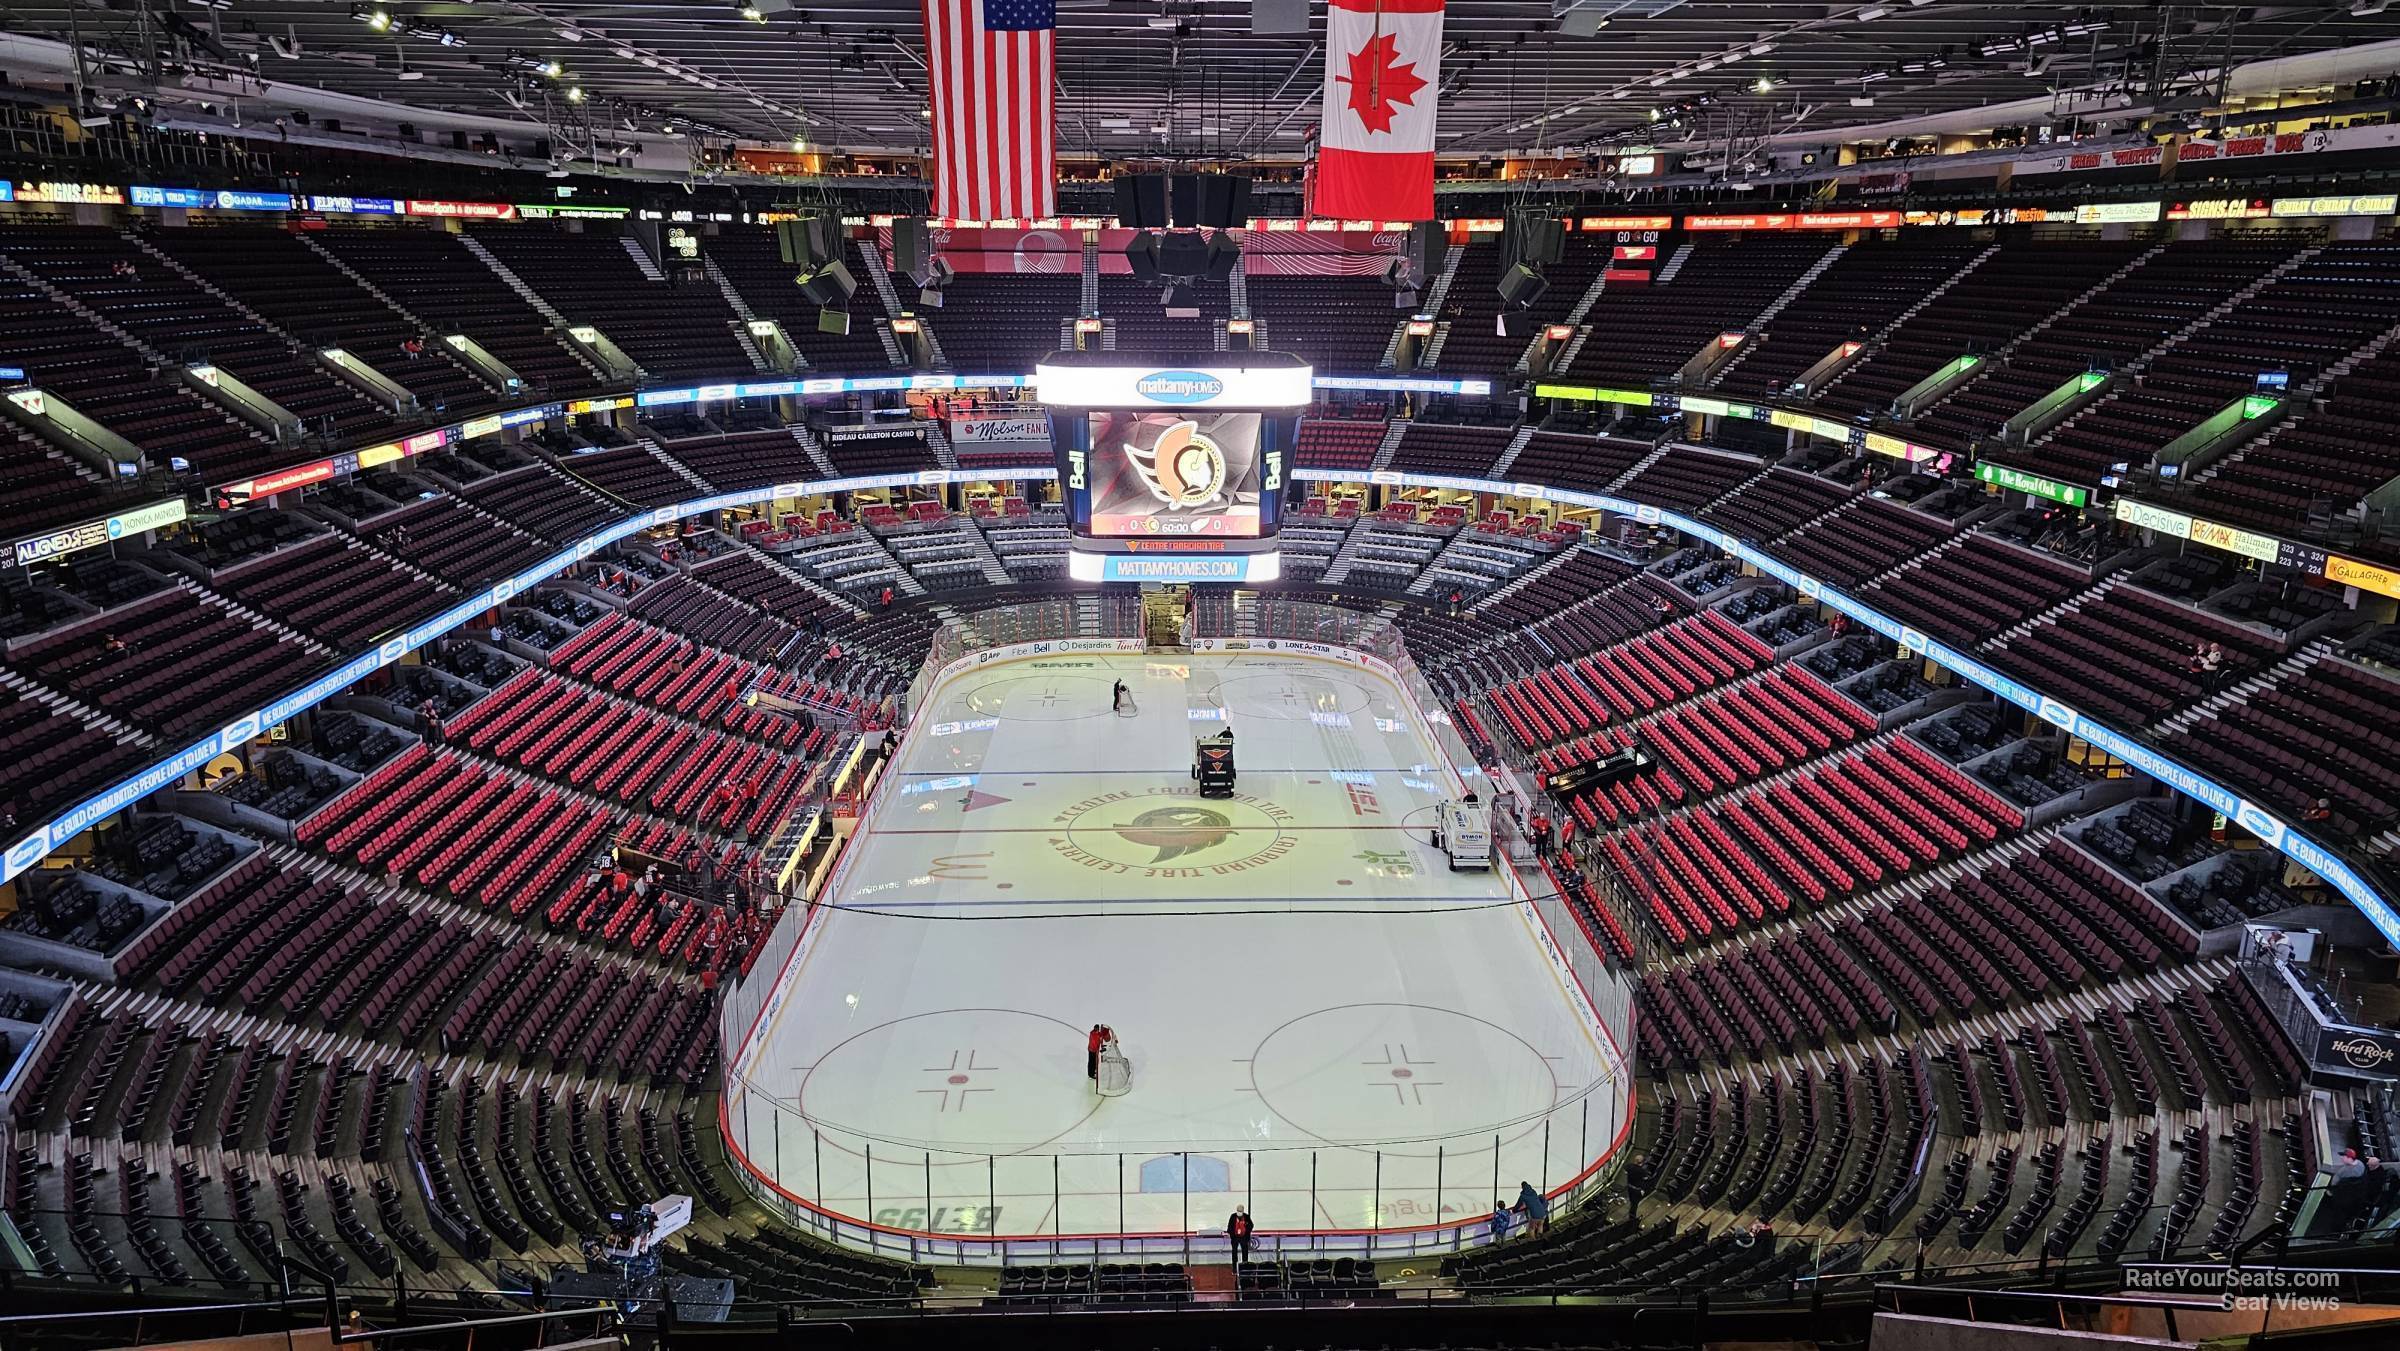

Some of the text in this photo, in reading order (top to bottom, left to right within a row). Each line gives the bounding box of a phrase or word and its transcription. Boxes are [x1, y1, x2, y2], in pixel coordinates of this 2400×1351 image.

[39, 182, 101, 204] SIGNS.CA
[2189, 199, 2247, 218] SIGNS.CA
[1617, 231, 1630, 243] GO
[1643, 231, 1658, 243] GO!
[831, 430, 915, 442] RIDEAU CARLETON CASINO
[976, 421, 1041, 438] Molson FAN
[1069, 450, 1085, 490] Bell
[1266, 450, 1282, 491] Bell
[2015, 474, 2037, 493] Royal
[2133, 505, 2185, 535] Decisive
[2281, 543, 2295, 554] 323
[1, 558, 14, 569] 207
[2279, 556, 2292, 567] 223
[2310, 552, 2325, 562] 324
[1118, 561, 1238, 576] MATTAMYHOMES.COM
[2308, 565, 2322, 575] 224
[2336, 565, 2389, 586] GALLAGHER
[1034, 643, 1051, 653] Bell
[1071, 641, 1112, 651] Desjardins
[2331, 1040, 2394, 1062] Hard Rock
